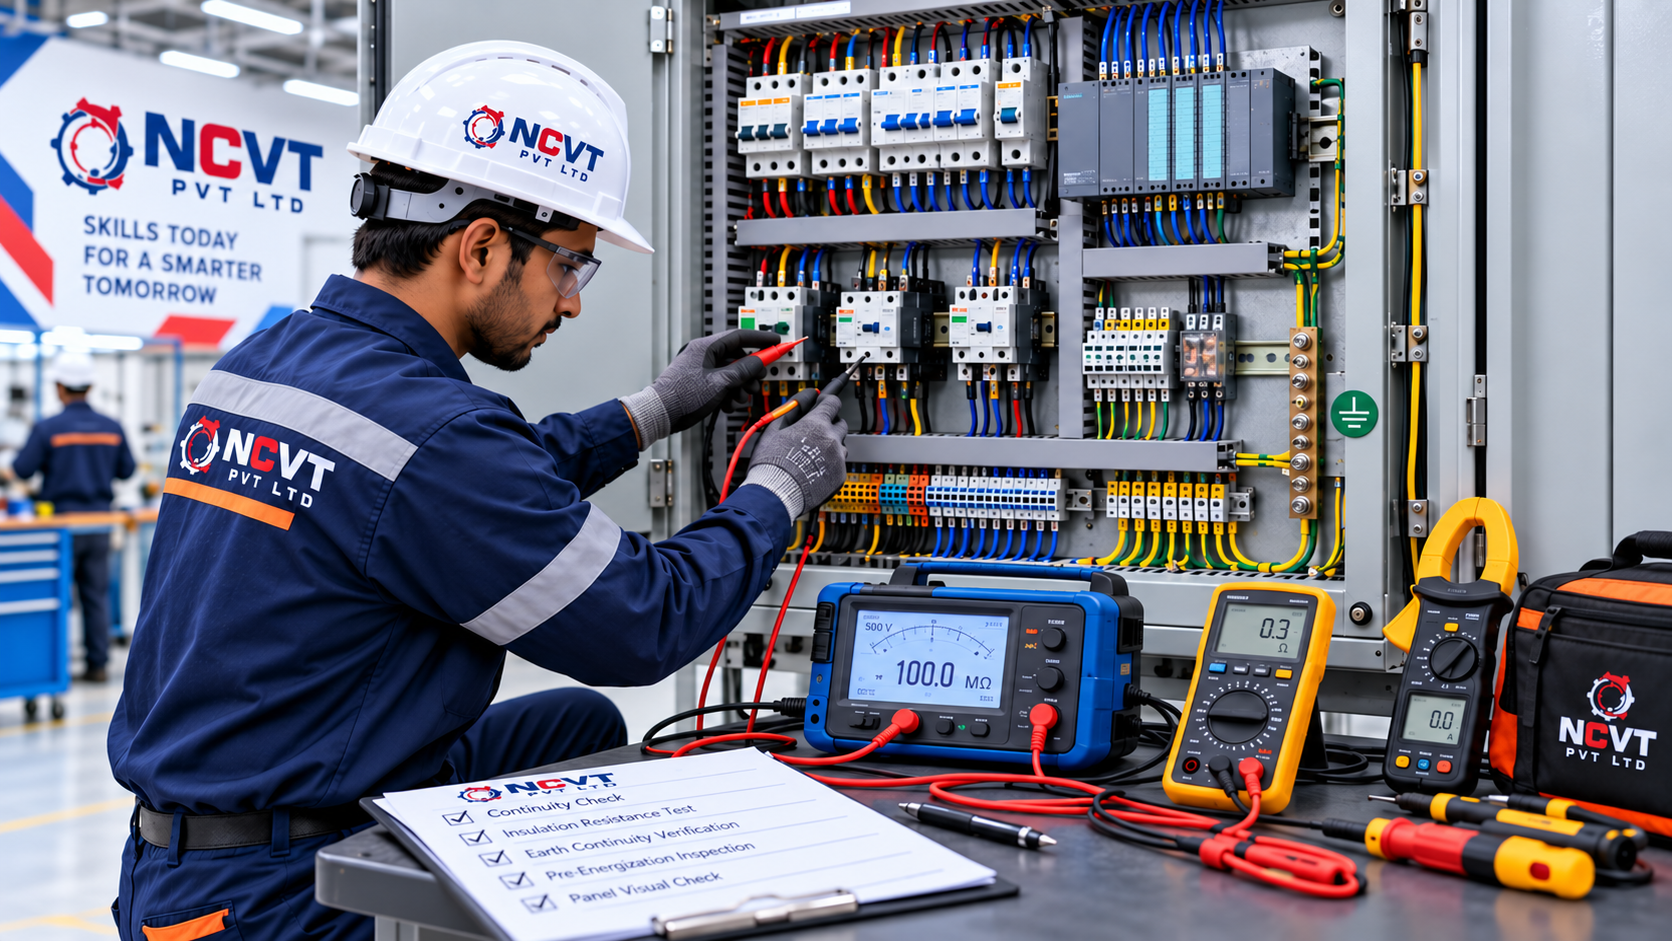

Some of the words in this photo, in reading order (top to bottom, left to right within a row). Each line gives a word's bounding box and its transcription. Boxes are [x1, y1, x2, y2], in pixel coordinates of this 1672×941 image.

[145, 111, 323, 192] NCVT
[509, 117, 604, 172] NCVT
[519, 150, 552, 168] PVT
[560, 164, 588, 182] LTD
[172, 179, 232, 203] PVT
[253, 191, 304, 213] LTD
[84, 215, 159, 241] SKILLS
[168, 225, 238, 250] TODAY
[84, 245, 129, 269] FOR
[138, 251, 153, 271] A
[162, 253, 262, 282] SMARTER
[83, 274, 217, 305] TOMORROW
[222, 428, 336, 492] NCVT
[228, 468, 262, 488] PVT
[271, 481, 313, 509] LTD
[884, 623, 893, 632] V
[1259, 617, 1291, 640] 0.3
[896, 659, 955, 688] 100.0
[964, 675, 992, 690] MΩ
[1429, 709, 1454, 730] 0.0
[1558, 715, 1658, 757] NCVT
[1566, 747, 1600, 763] PVT
[1612, 755, 1646, 770] LTD
[504, 772, 614, 794] NCVT
[487, 801, 571, 818] Continuity
[575, 793, 626, 806] Check
[502, 818, 579, 838] Insulation
[580, 810, 661, 828] Resistance
[661, 804, 697, 816] Test
[525, 845, 570, 859] Earth
[571, 834, 652, 852] Continuity
[653, 820, 740, 840] Verification
[545, 854, 676, 882] Pre-Energization
[675, 842, 756, 860] Inspection
[568, 888, 618, 904] Panel
[618, 879, 671, 896] Visual
[672, 871, 724, 887] Check
